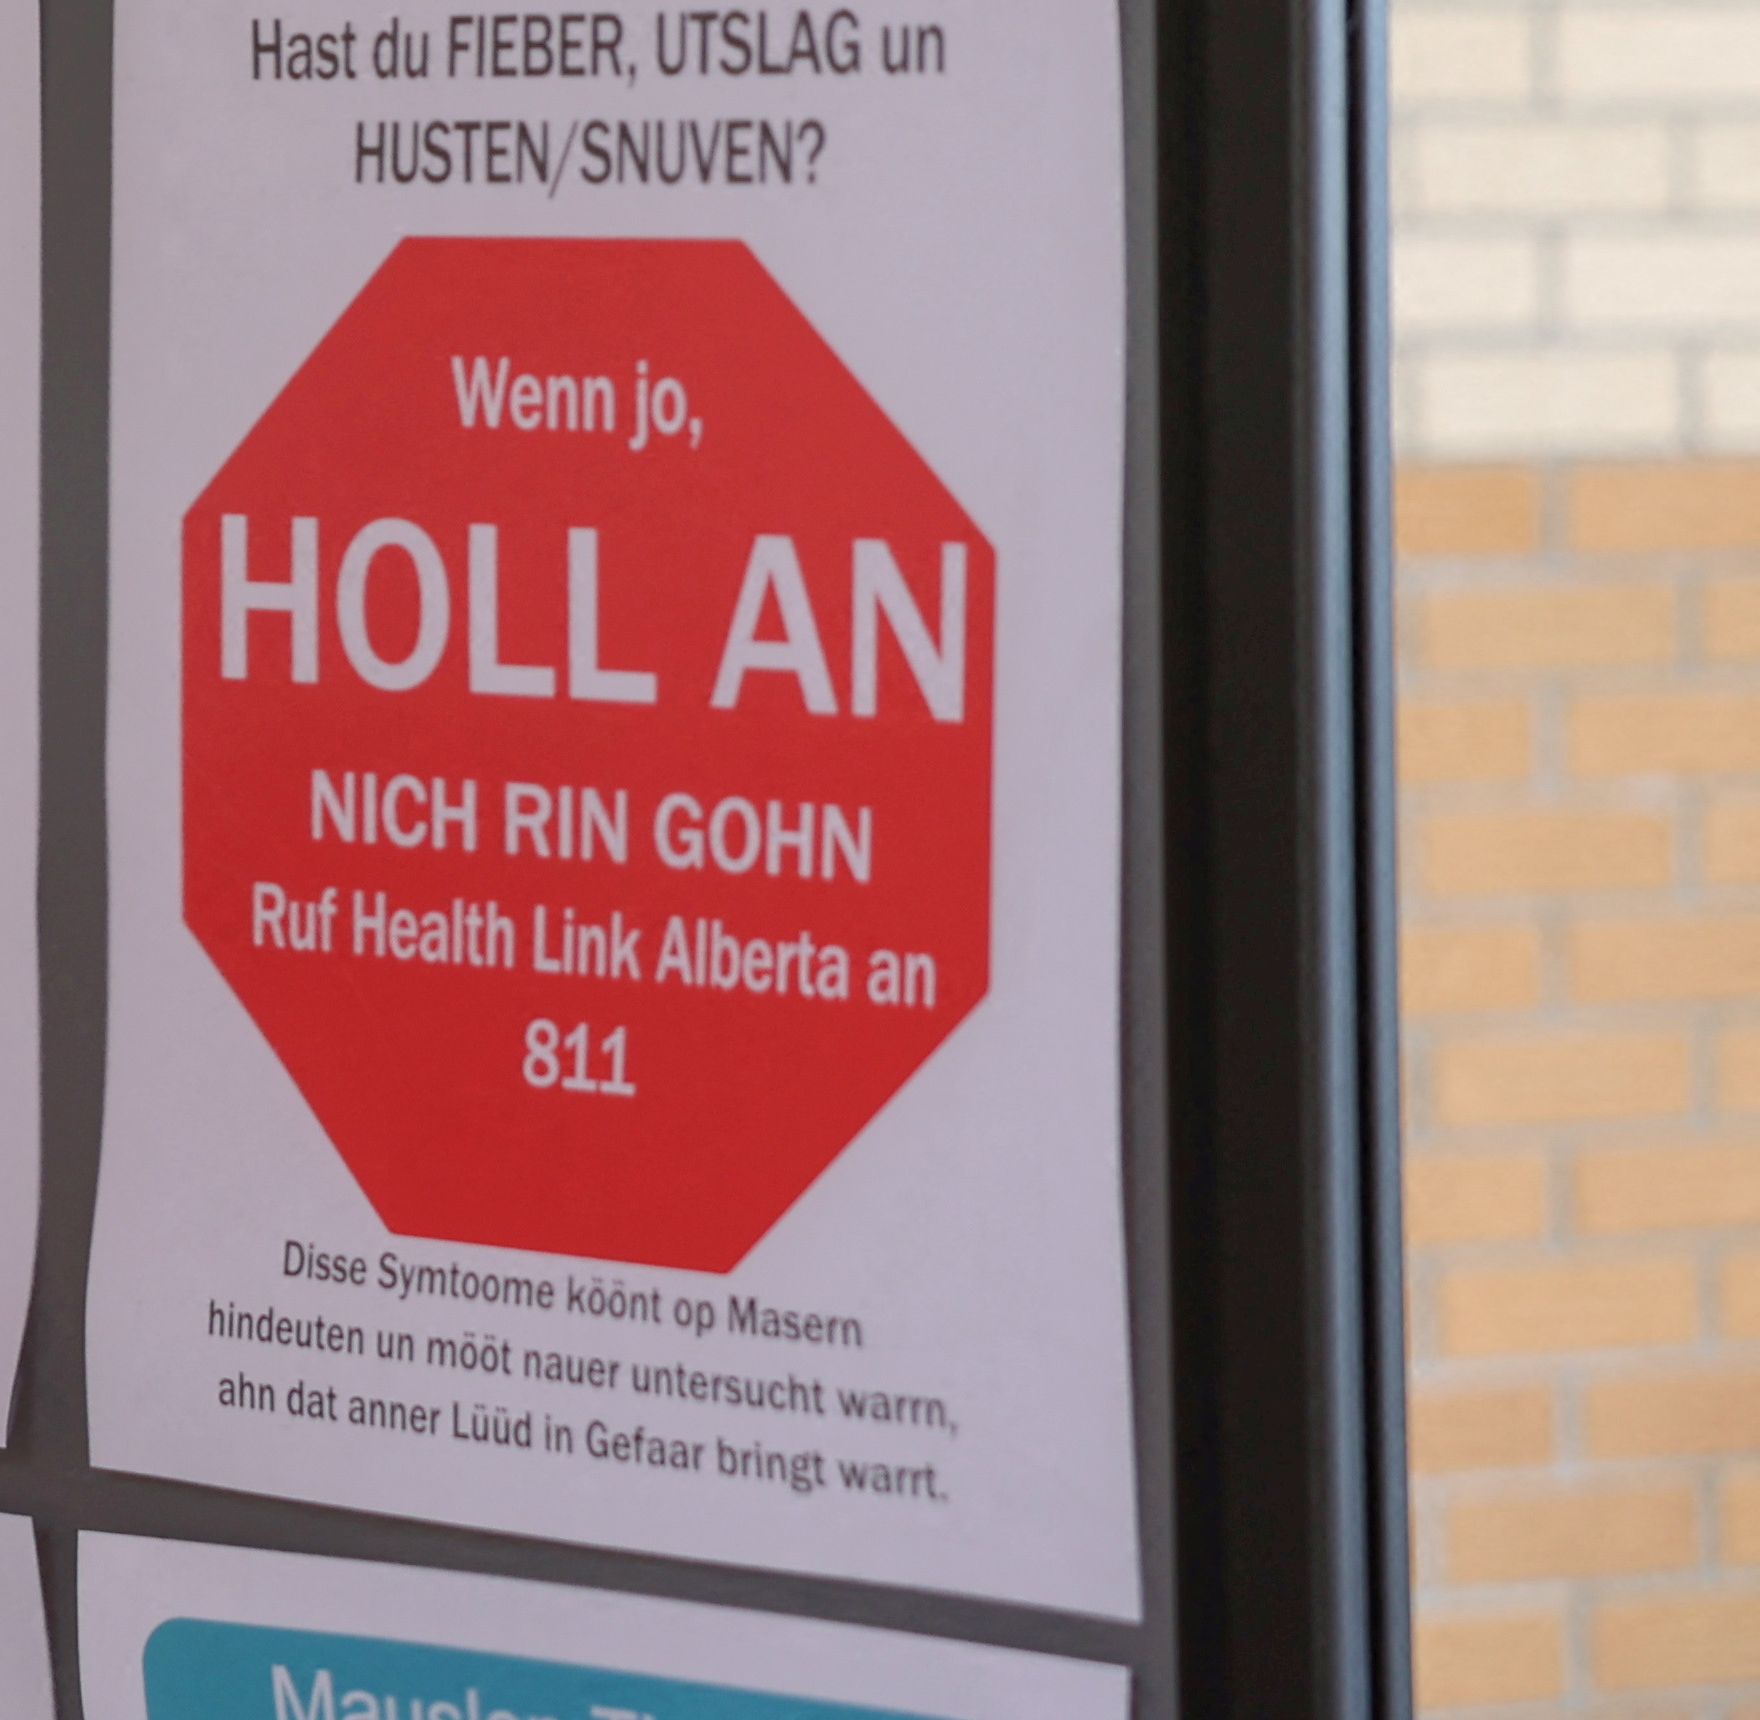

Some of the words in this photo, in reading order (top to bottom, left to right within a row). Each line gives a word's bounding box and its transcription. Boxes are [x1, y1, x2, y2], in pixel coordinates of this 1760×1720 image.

[252, 19, 356, 80] Hast
[372, 17, 428, 79] du
[449, 13, 635, 86] FIEBER,
[657, 9, 860, 76] UTSLAG
[882, 23, 944, 74] un
[356, 120, 825, 196] HUSTEN/SNUVEN?
[452, 357, 614, 431] Wenn
[629, 360, 702, 451] jo,
[221, 514, 657, 704] HOLL
[711, 535, 967, 722] AN
[312, 770, 476, 851] NICH
[506, 783, 626, 862] RIN
[655, 793, 871, 882] GOHN
[254, 883, 336, 951] Ruf
[354, 891, 514, 967] Health
[534, 905, 640, 979] Link
[656, 916, 848, 999] Alberta
[868, 950, 935, 1006] an
[523, 1019, 635, 1096] 811
[283, 1240, 367, 1286] Disse
[378, 1252, 554, 1309] Symtoome
[567, 1275, 661, 1324] köönt
[673, 1298, 716, 1338] op
[728, 1295, 863, 1347] Masern
[209, 1299, 363, 1355] hindeuten
[377, 1331, 414, 1361] un
[427, 1332, 511, 1375] mööt
[524, 1350, 620, 1388] nauer
[632, 1363, 825, 1415] untersucht
[837, 1389, 957, 1440] warrn,
[219, 1372, 275, 1412] ahn
[287, 1380, 337, 1421] dat
[348, 1396, 441, 1435] anner
[453, 1401, 532, 1448] Lüüd
[545, 1415, 573, 1454] in
[585, 1420, 704, 1471] Gefaar
[717, 1438, 825, 1494] bringt
[838, 1461, 946, 1500] warrt.
